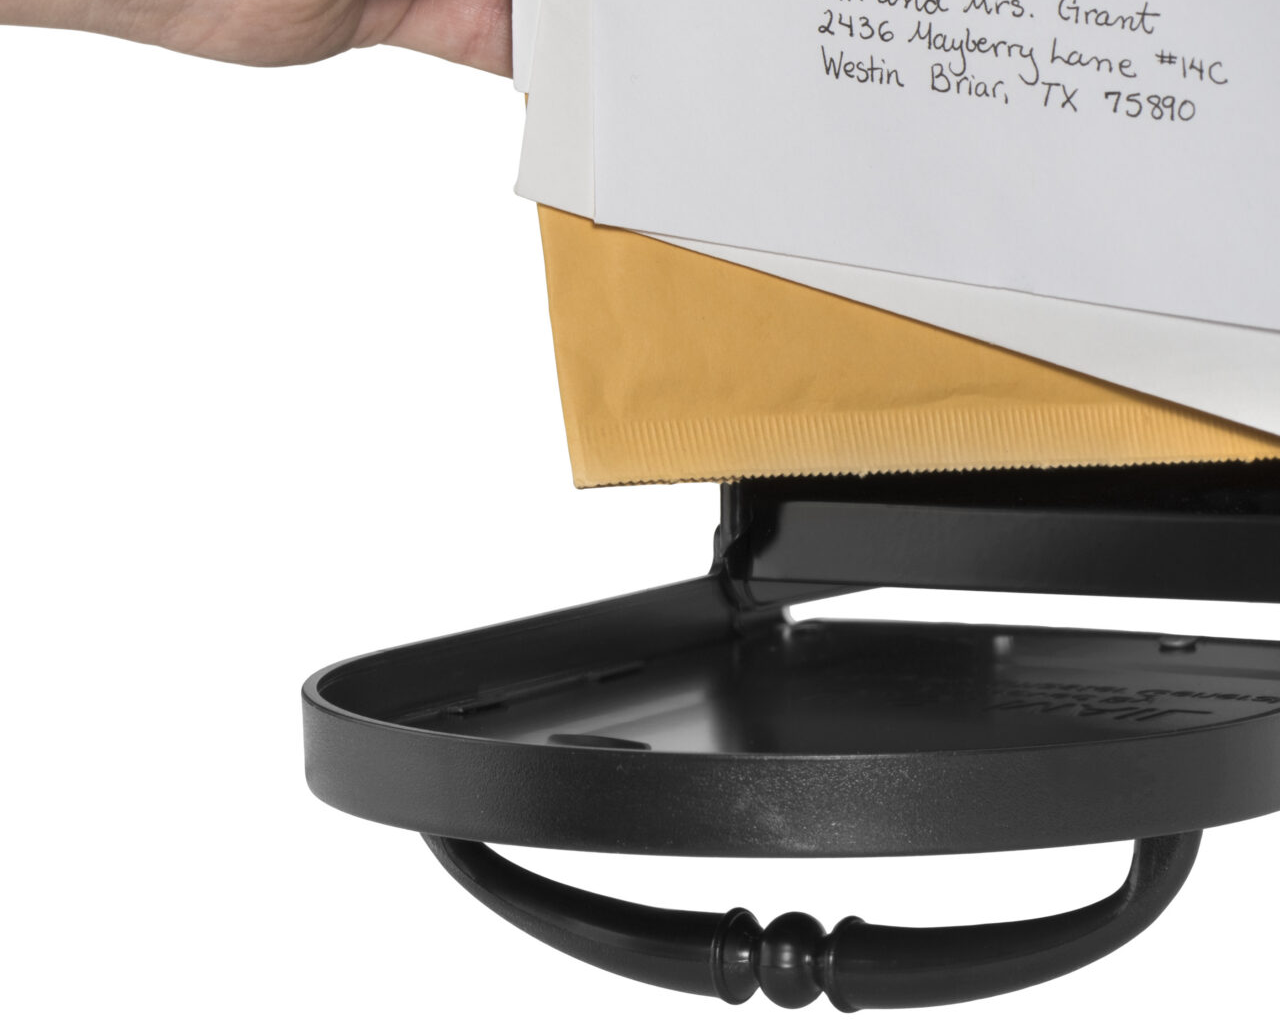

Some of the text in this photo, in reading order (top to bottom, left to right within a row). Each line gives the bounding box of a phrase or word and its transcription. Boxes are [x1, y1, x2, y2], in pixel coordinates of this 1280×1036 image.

[817, 8, 1229, 87] 2436 Mayberry Lane #14C
[820, 44, 1197, 122] Westin Briar, TX 75890
